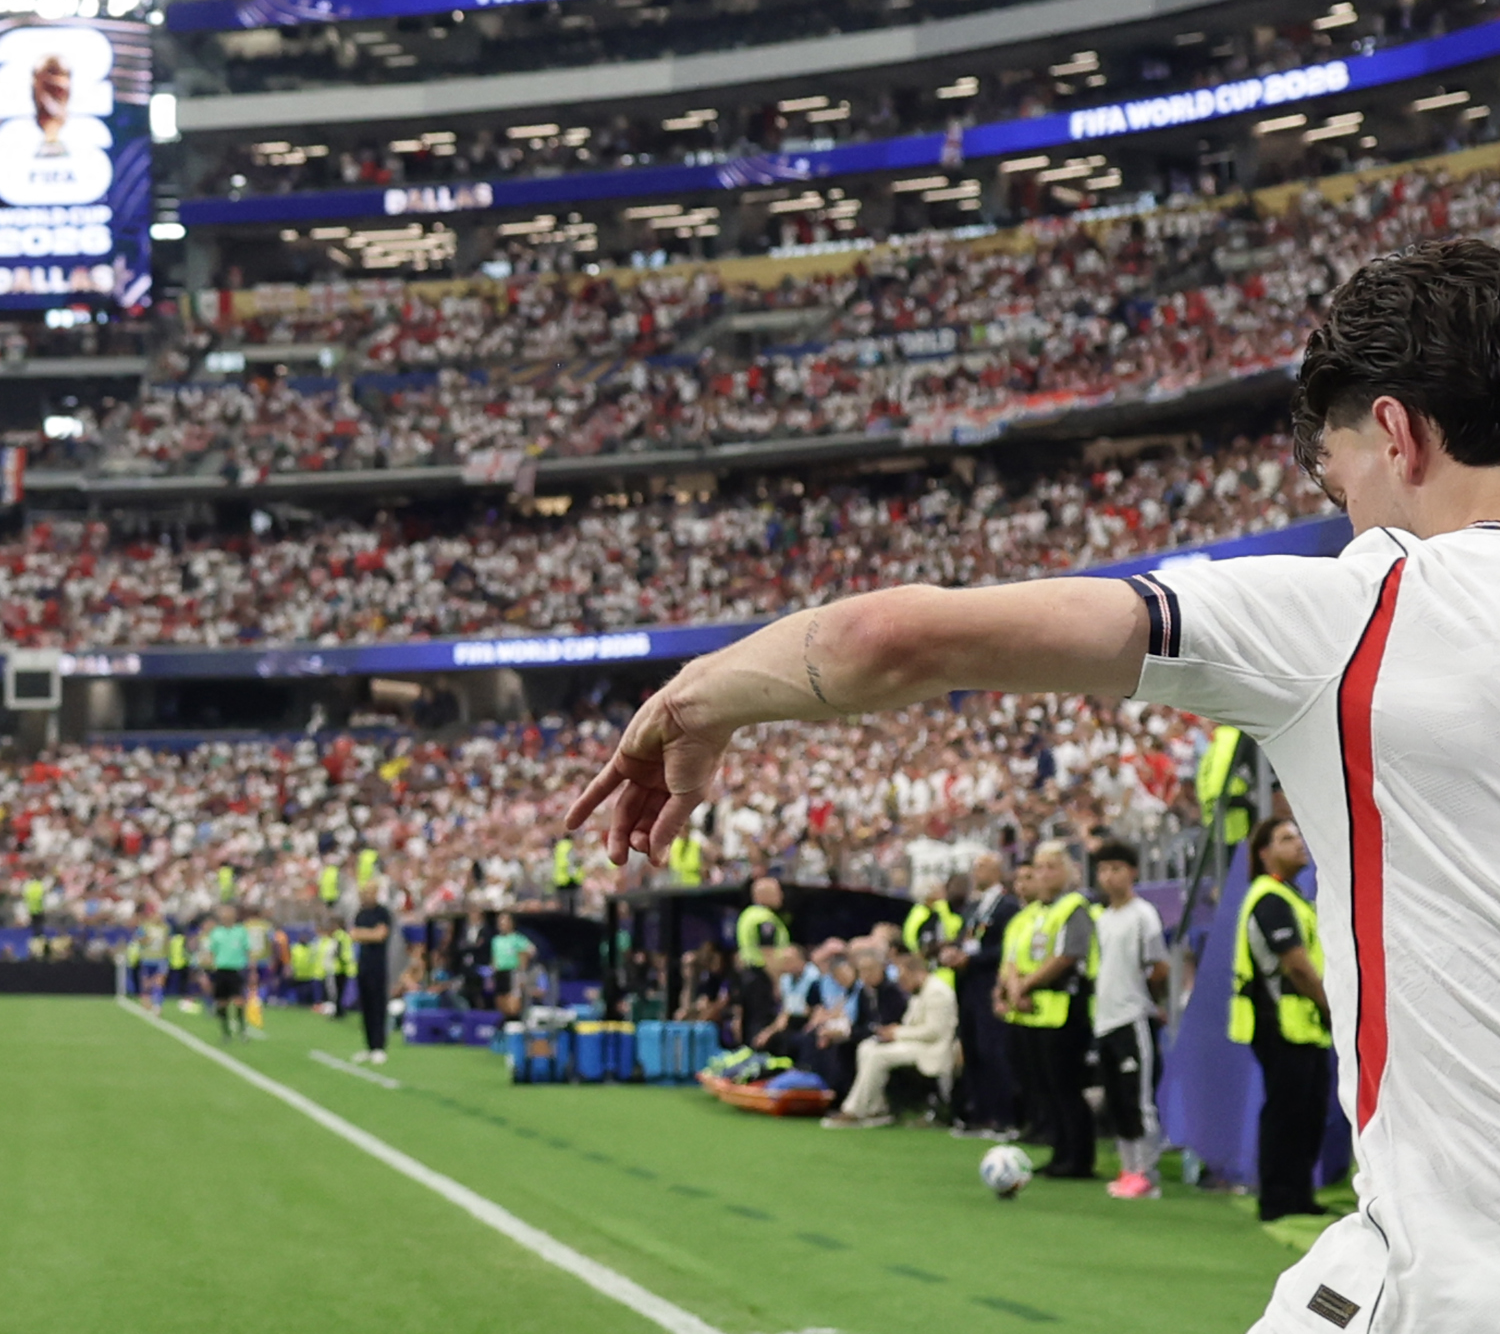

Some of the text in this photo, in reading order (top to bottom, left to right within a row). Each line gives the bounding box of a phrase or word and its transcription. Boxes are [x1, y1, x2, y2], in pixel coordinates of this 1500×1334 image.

[1069, 60, 1350, 140] FIFA WORLD CUP 2026
[384, 181, 494, 215] DALLAS
